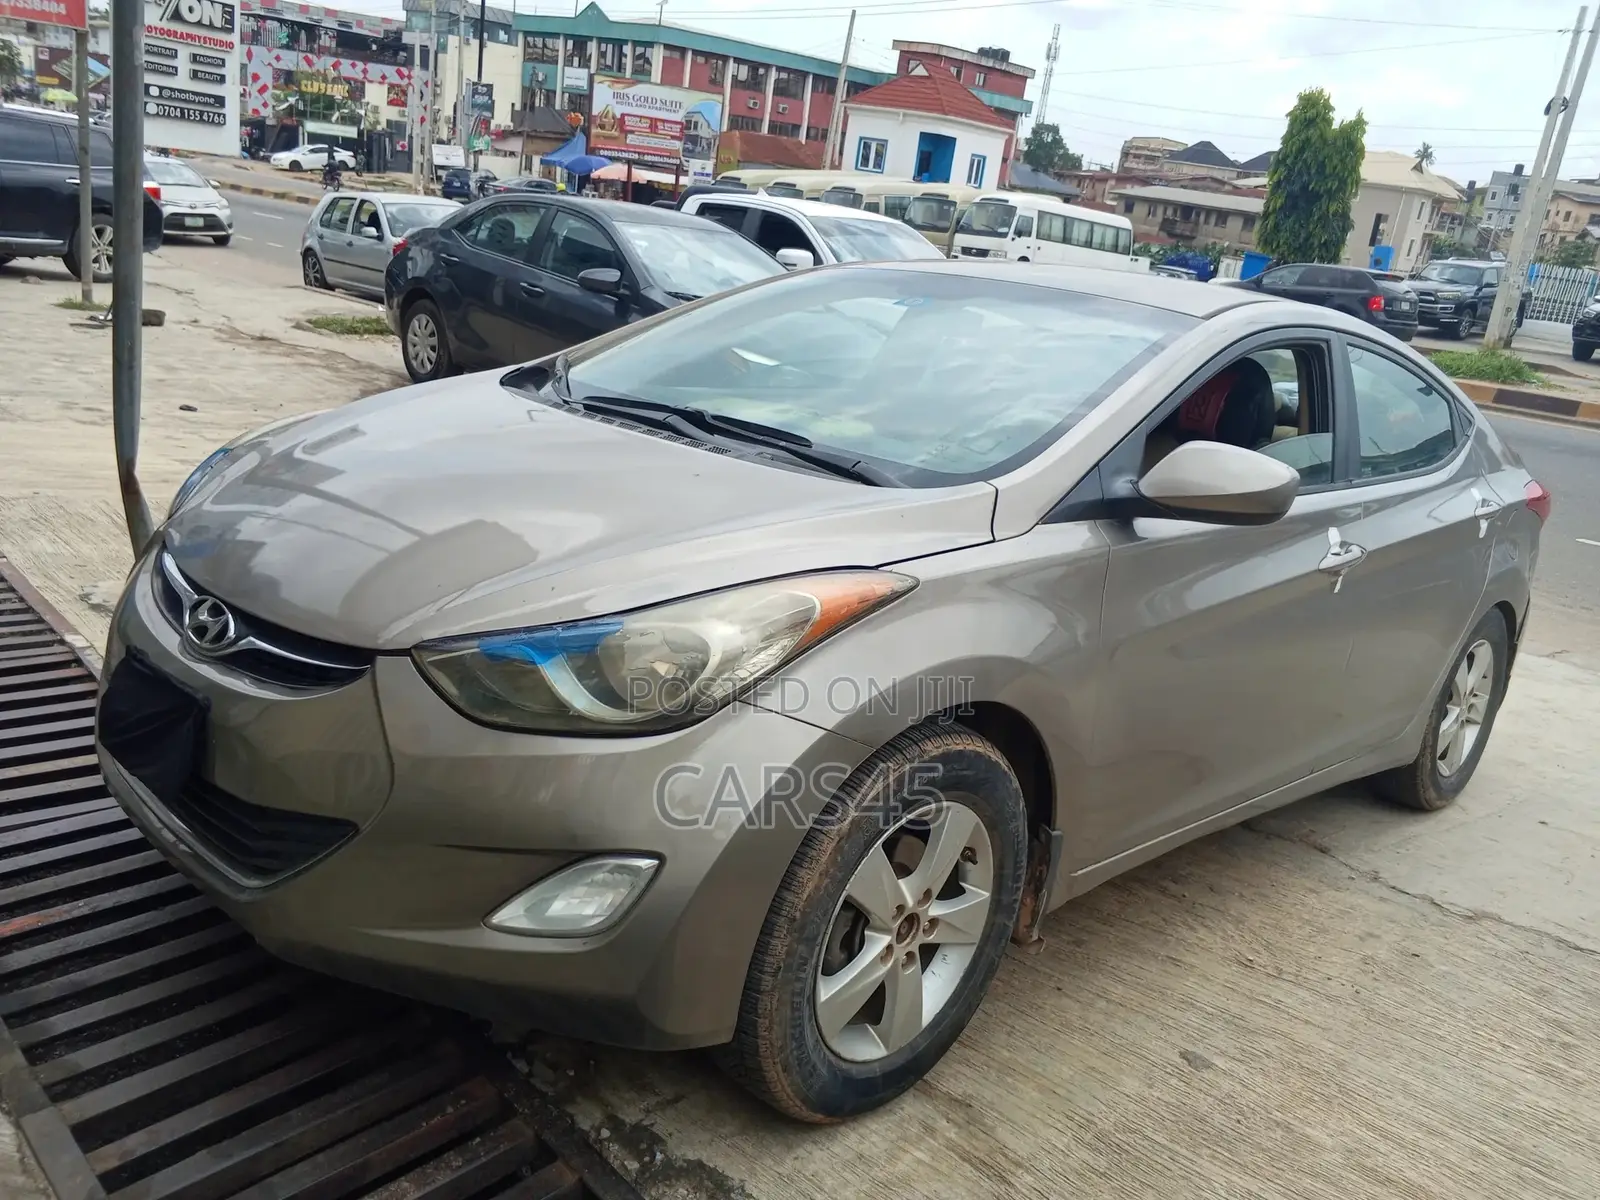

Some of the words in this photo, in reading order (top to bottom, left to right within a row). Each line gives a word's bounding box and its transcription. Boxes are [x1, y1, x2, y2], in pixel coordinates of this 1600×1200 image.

[196, 56, 222, 66] FASHION
[197, 71, 221, 81] BEAUTY
[161, 88, 220, 107] @shotbyone_
[612, 91, 630, 101] IRIS
[632, 94, 658, 106] GOLD
[659, 98, 684, 110] SUITE
[158, 105, 181, 118] 0704
[184, 109, 201, 121] 155
[202, 112, 225, 124] 4766
[648, 105, 680, 114] APARTMENT
